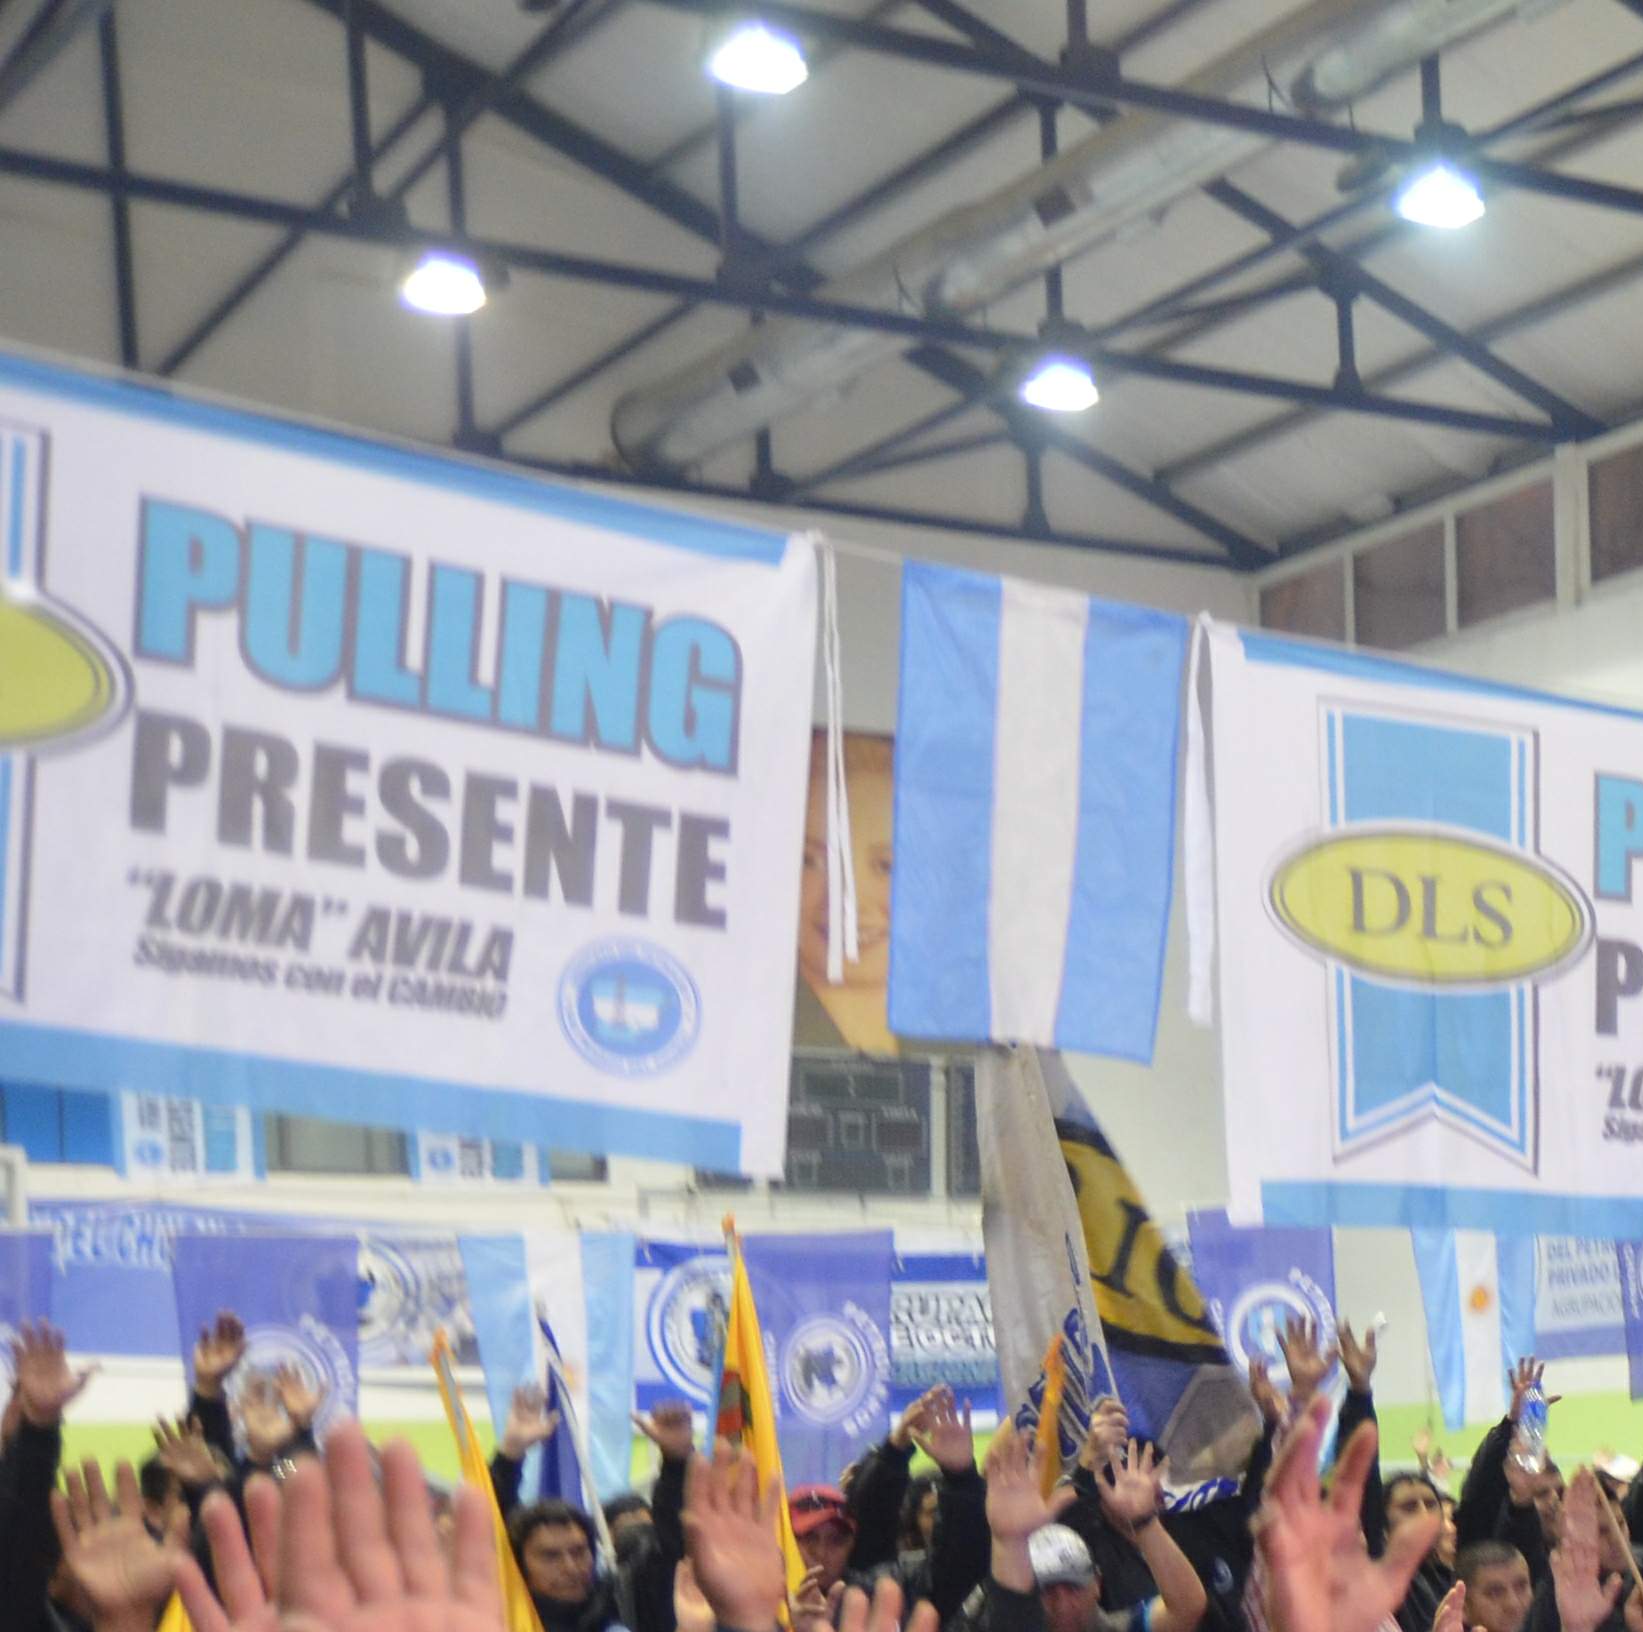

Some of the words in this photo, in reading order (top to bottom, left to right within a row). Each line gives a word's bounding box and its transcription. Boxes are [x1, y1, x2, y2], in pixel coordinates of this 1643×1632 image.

[133, 492, 744, 778] PULLING
[129, 706, 732, 931] PRESENTE
[348, 904, 515, 984] AVILA
[1348, 866, 1513, 947] DLS
